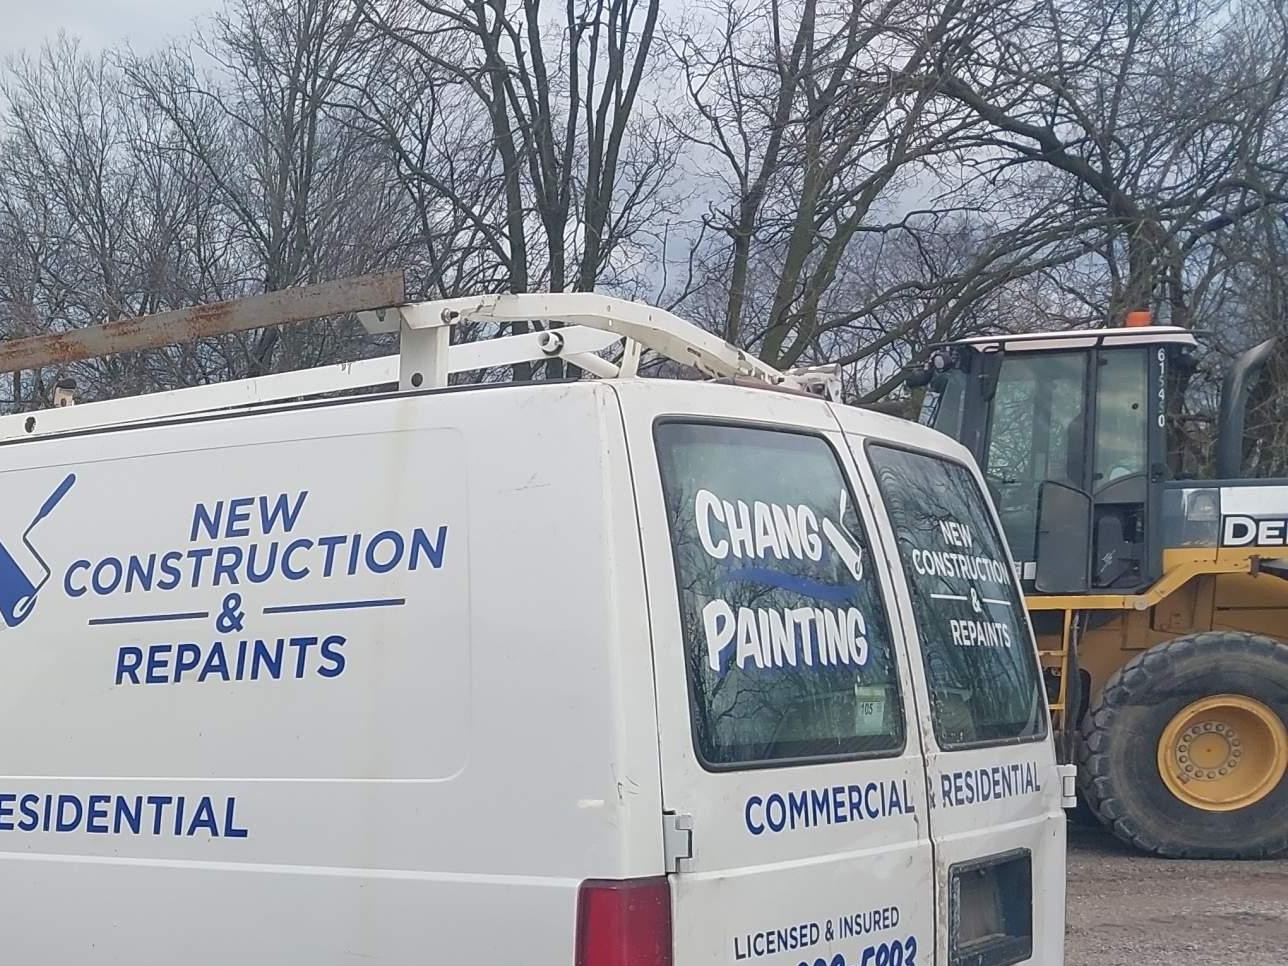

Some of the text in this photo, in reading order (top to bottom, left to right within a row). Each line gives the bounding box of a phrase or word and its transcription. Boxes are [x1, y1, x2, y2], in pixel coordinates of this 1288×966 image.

[190, 491, 308, 541] NEW
[695, 489, 822, 561] CHANG
[939, 520, 972, 548] NEW
[1223, 516, 1288, 546] DE
[63, 526, 448, 597] CONSTRUCTION
[912, 549, 1011, 585] CONSTRUCTION
[215, 592, 245, 633] &
[970, 587, 982, 613] &
[702, 599, 869, 672] PAINTING
[950, 620, 1012, 648] REPAINTS
[115, 635, 347, 685] REPAINTS
[745, 779, 915, 835] COMMERCIAL
[941, 761, 1041, 808] RESIDENTIAL
[734, 906, 900, 961] LICENSED & INSURED
